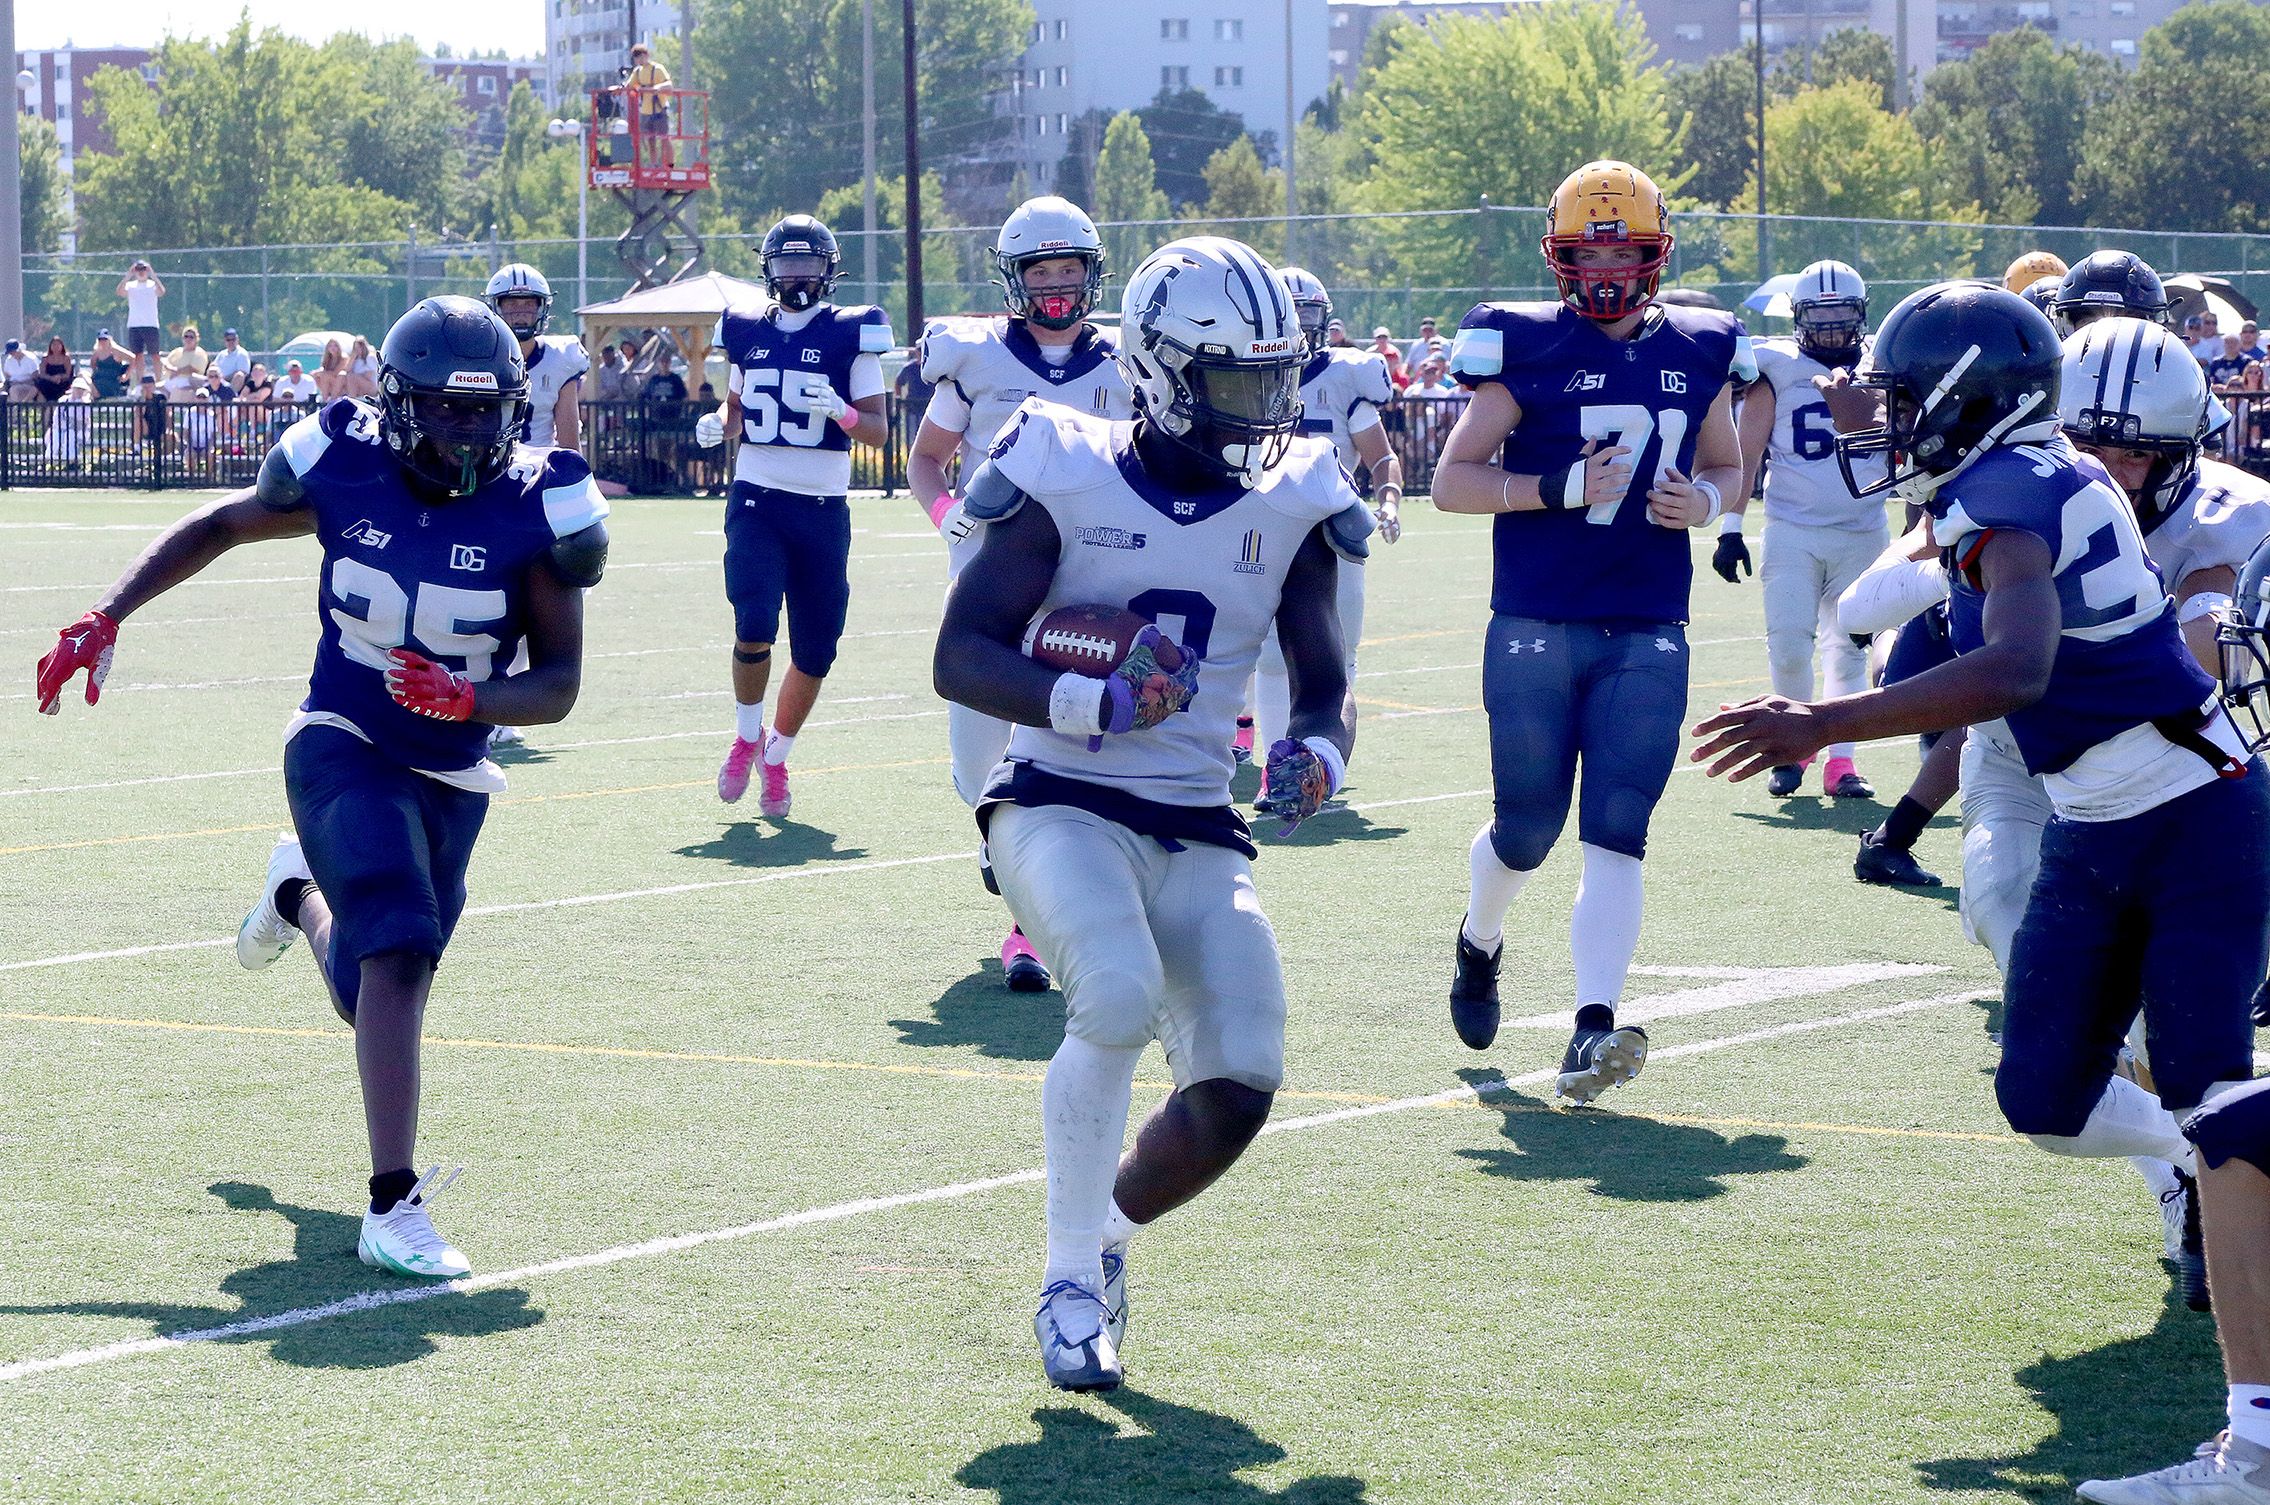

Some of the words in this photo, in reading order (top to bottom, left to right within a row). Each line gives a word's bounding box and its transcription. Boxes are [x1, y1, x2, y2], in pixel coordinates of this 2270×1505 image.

[1041, 241, 1069, 249] Riddell
[801, 348, 821, 363] DG
[1252, 341, 1288, 354] Riddell
[455, 375, 493, 384] Riddell
[1049, 369, 1066, 379] SCF
[1564, 370, 1606, 392] A51
[1660, 370, 1687, 393] DG
[740, 368, 830, 447] 55
[2100, 416, 2118, 427] F7
[1580, 404, 1687, 525] 71
[1173, 501, 1196, 516] SCF
[341, 519, 392, 549] A51
[450, 543, 487, 572] DG
[329, 556, 507, 683] 25
